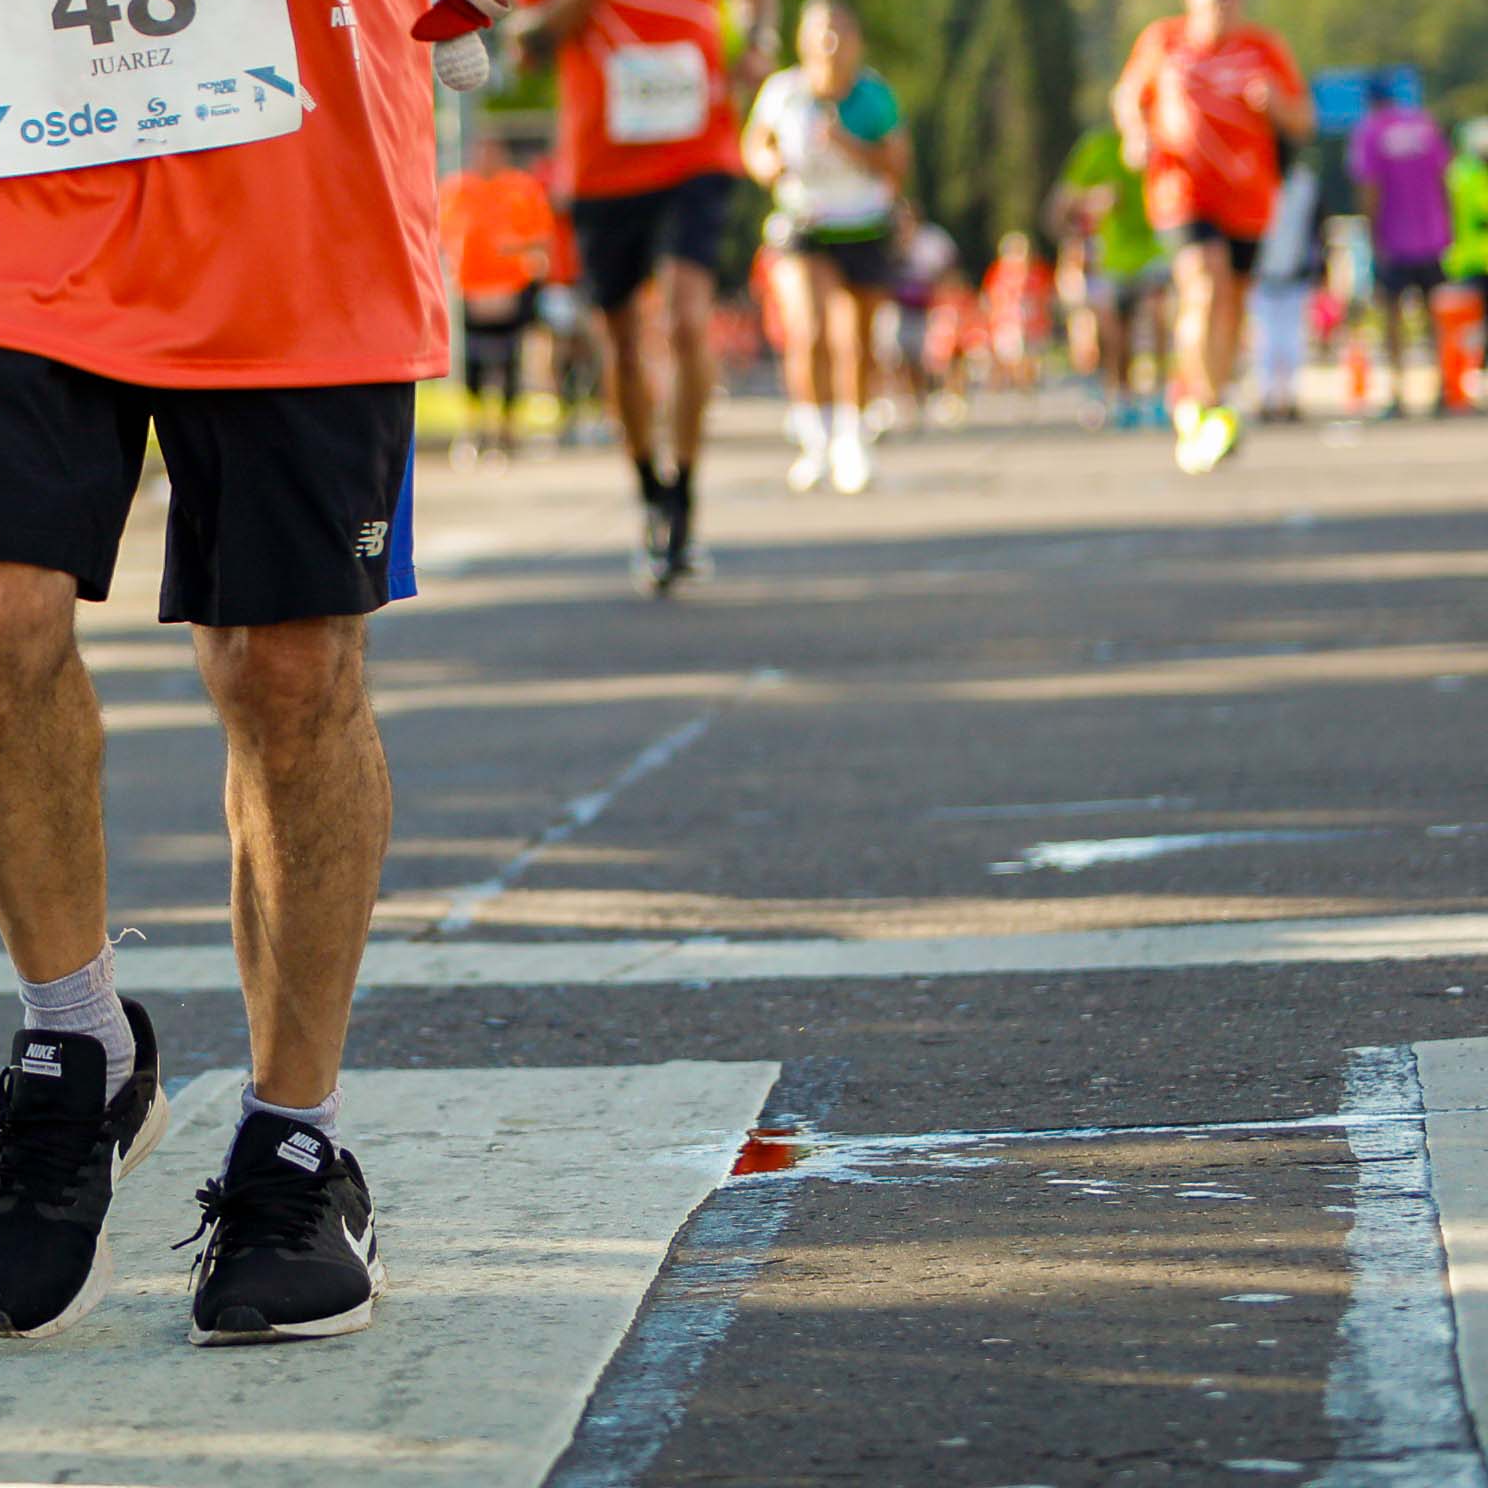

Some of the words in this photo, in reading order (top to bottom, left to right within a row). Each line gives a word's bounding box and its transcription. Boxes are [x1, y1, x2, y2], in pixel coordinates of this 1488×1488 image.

[90, 47, 173, 77] JUAREZ
[19, 102, 118, 146] osde
[25, 1043, 56, 1060] NIKE
[287, 1131, 321, 1155] NIKE
